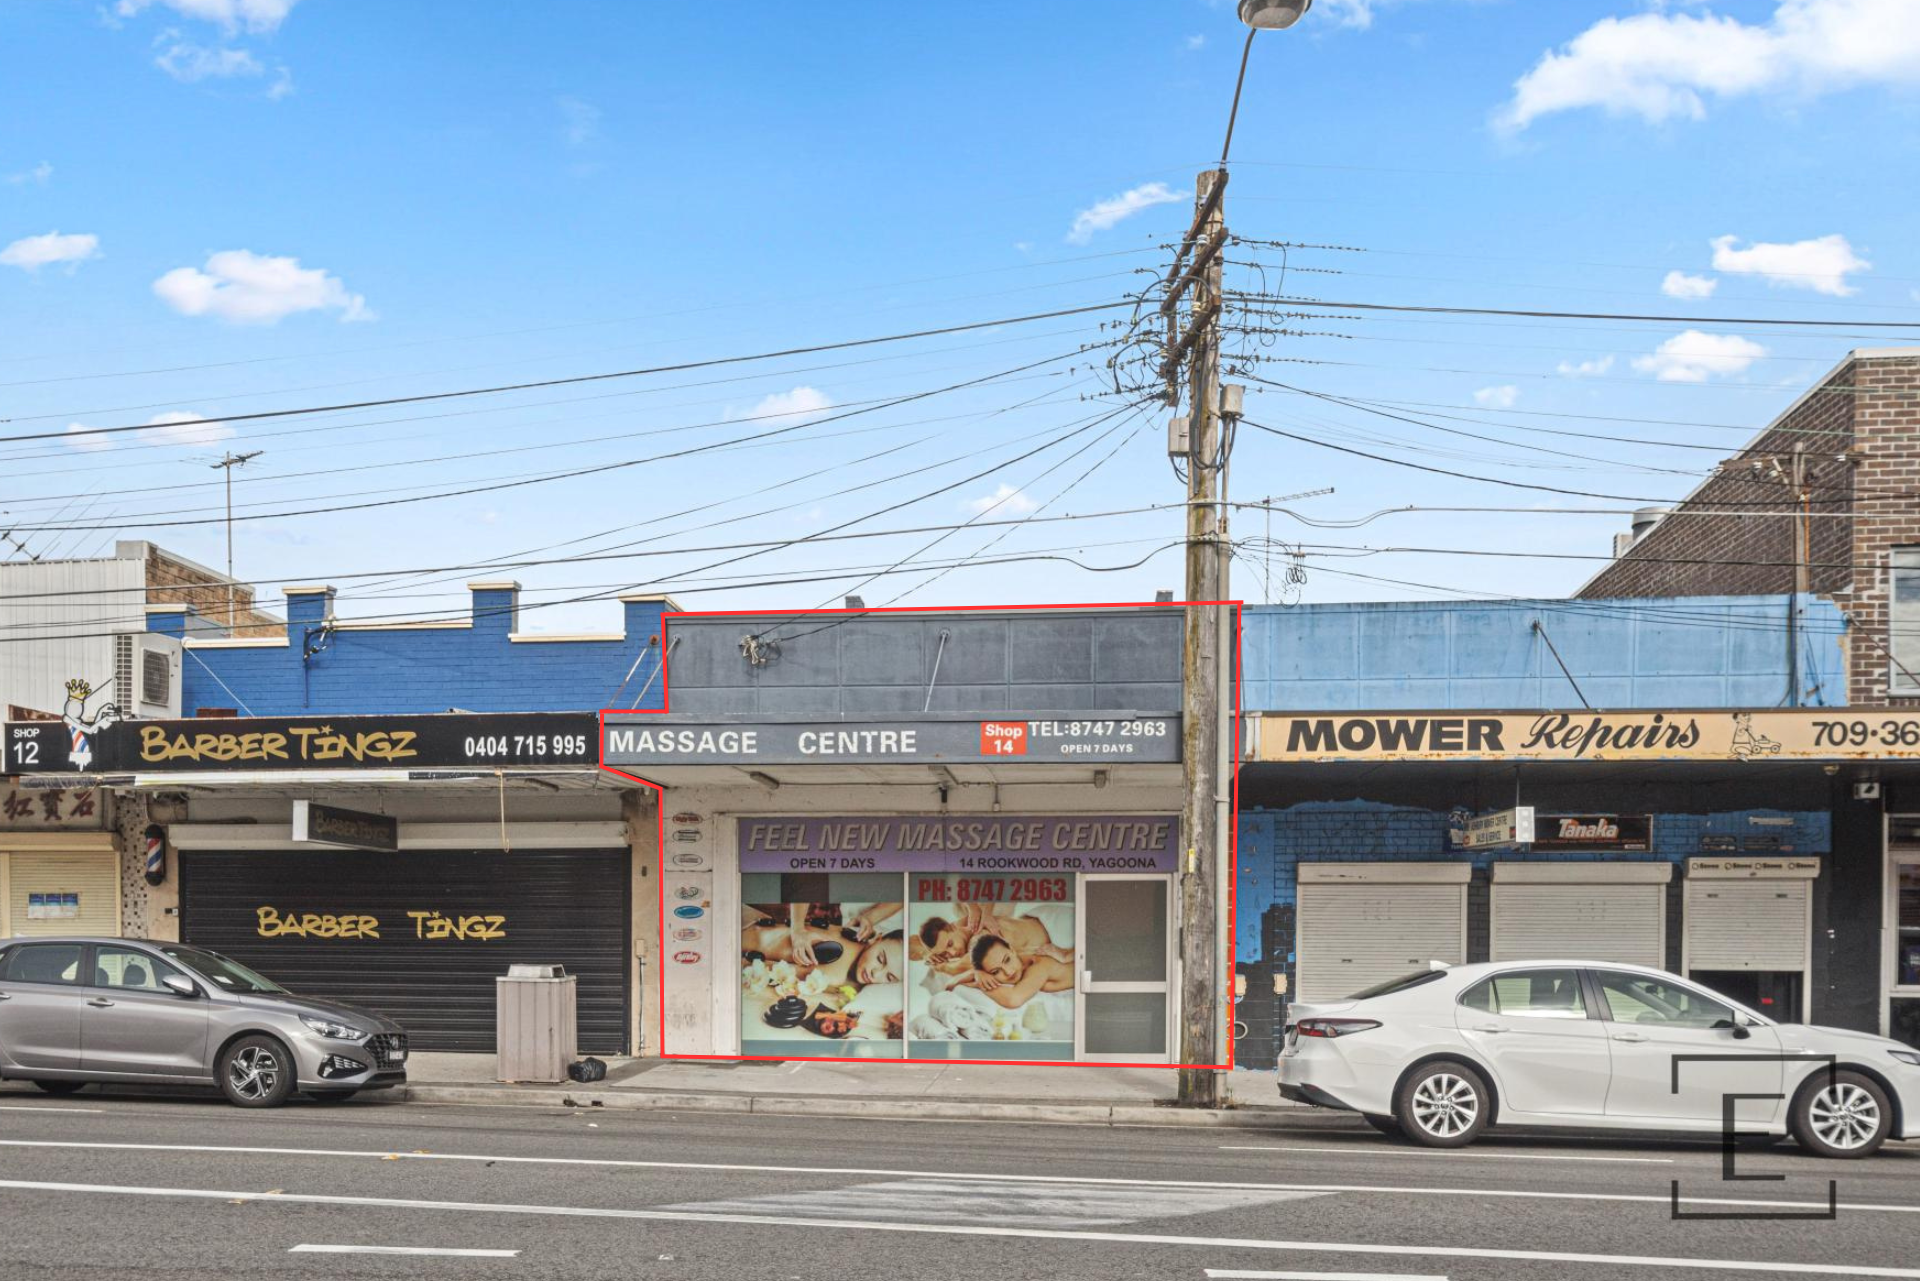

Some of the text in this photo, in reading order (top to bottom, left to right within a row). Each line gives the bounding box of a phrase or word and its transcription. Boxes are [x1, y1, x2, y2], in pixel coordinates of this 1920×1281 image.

[13, 728, 40, 738] SHOP
[985, 724, 1023, 738] Shop
[1028, 721, 1166, 737] TEL:8747 2963
[1286, 713, 1700, 758] MOWER Repairs
[13, 741, 39, 764] 12
[140, 726, 289, 762] BARBER
[465, 735, 586, 757] 0404 715 995
[609, 731, 917, 754] MASSAGE CENTRE
[994, 740, 1014, 753] 14
[1060, 744, 1133, 754] OPEN 7 DAYS
[750, 822, 1169, 851] FEEL NEW MASSAGE CENTRE
[1558, 818, 1620, 839] Tanaka
[790, 858, 876, 869] OPEN 7 DAYS
[959, 857, 1157, 870] 14 ROOKWOOD RD, YAGOONA
[918, 878, 1067, 901] PH: 8747 2963
[256, 906, 380, 939] BARBER
